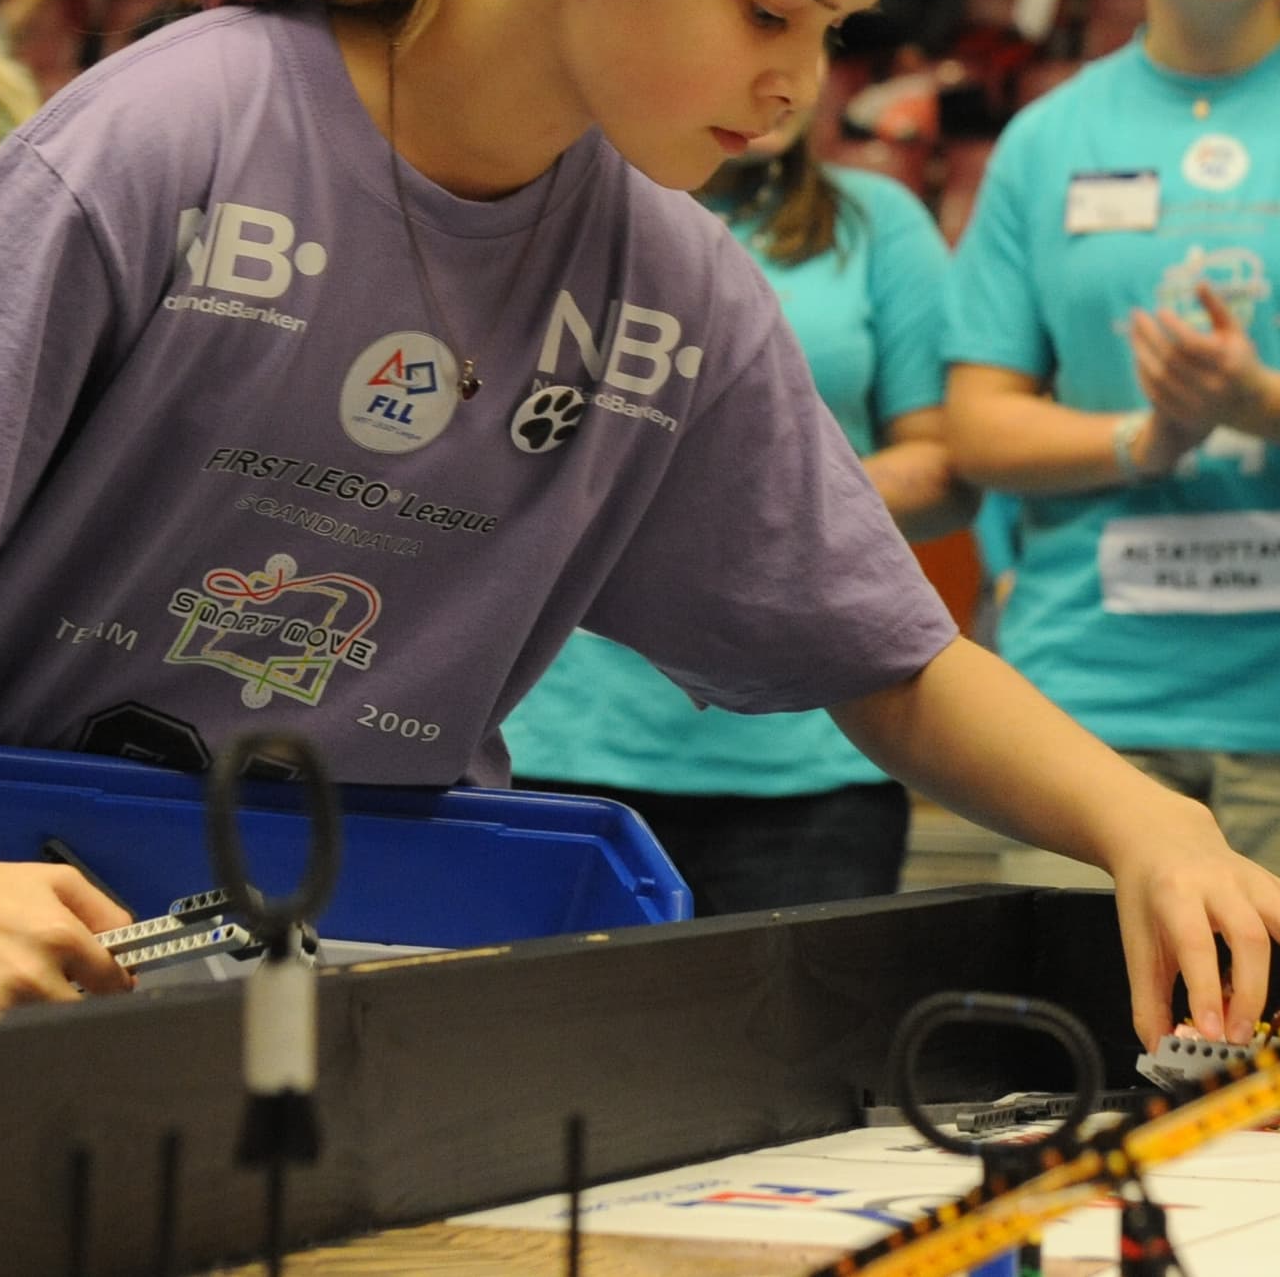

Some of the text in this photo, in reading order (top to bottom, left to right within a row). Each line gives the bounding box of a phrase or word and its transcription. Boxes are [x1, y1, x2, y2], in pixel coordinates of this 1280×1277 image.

[367, 394, 414, 425] FLL
[201, 448, 301, 480] FIRST
[397, 492, 498, 535] League
[235, 493, 425, 558] SCANDINAVIA
[55, 616, 139, 652] TEAM
[168, 589, 377, 670] SMART MOVE
[355, 703, 442, 743] 2009
